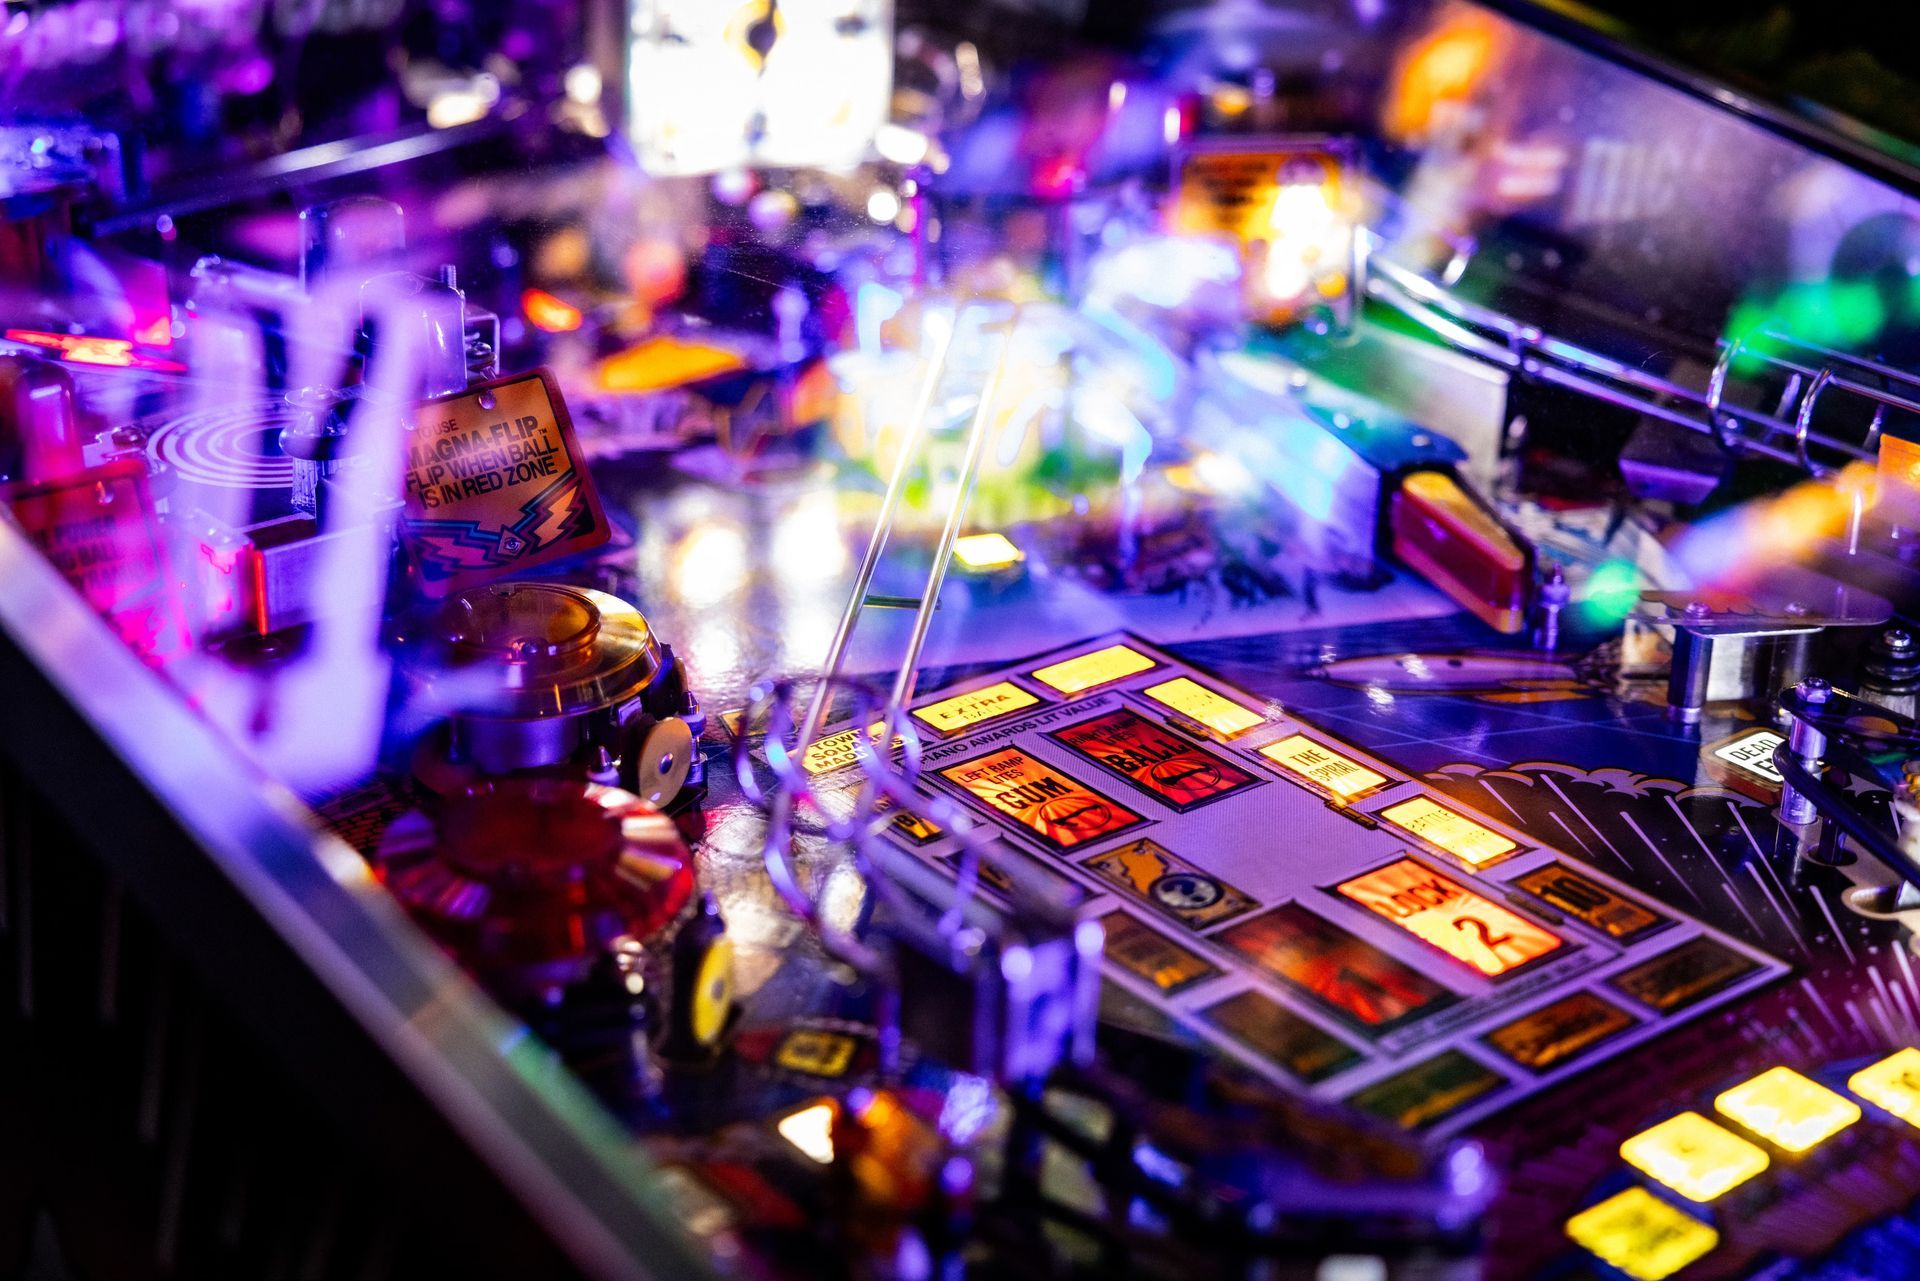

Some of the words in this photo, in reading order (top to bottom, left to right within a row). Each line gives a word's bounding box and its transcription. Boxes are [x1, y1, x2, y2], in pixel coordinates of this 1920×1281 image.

[433, 418, 460, 435] USE
[405, 464, 445, 493] FLIP
[446, 448, 508, 480] WHEN
[509, 436, 559, 464] BALL
[418, 489, 441, 510] IS
[440, 482, 463, 505] IN
[462, 471, 504, 498] RED
[503, 456, 558, 487] ZONE
[939, 694, 1012, 719] EXTRA
[919, 743, 969, 765] PIANO
[969, 721, 1038, 748] AWARDS
[1035, 712, 1060, 727] LIT
[1058, 697, 1112, 718] VALUE
[958, 768, 990, 783] LEFT
[986, 756, 1024, 773] RAMP
[1104, 738, 1192, 772] BALL
[1289, 749, 1330, 767] THE
[1308, 761, 1361, 781] SPIRAL
[986, 768, 1024, 785] LITES
[996, 776, 1074, 810] GUM
[1374, 879, 1461, 918] LOCK
[1451, 915, 1512, 948] 2
